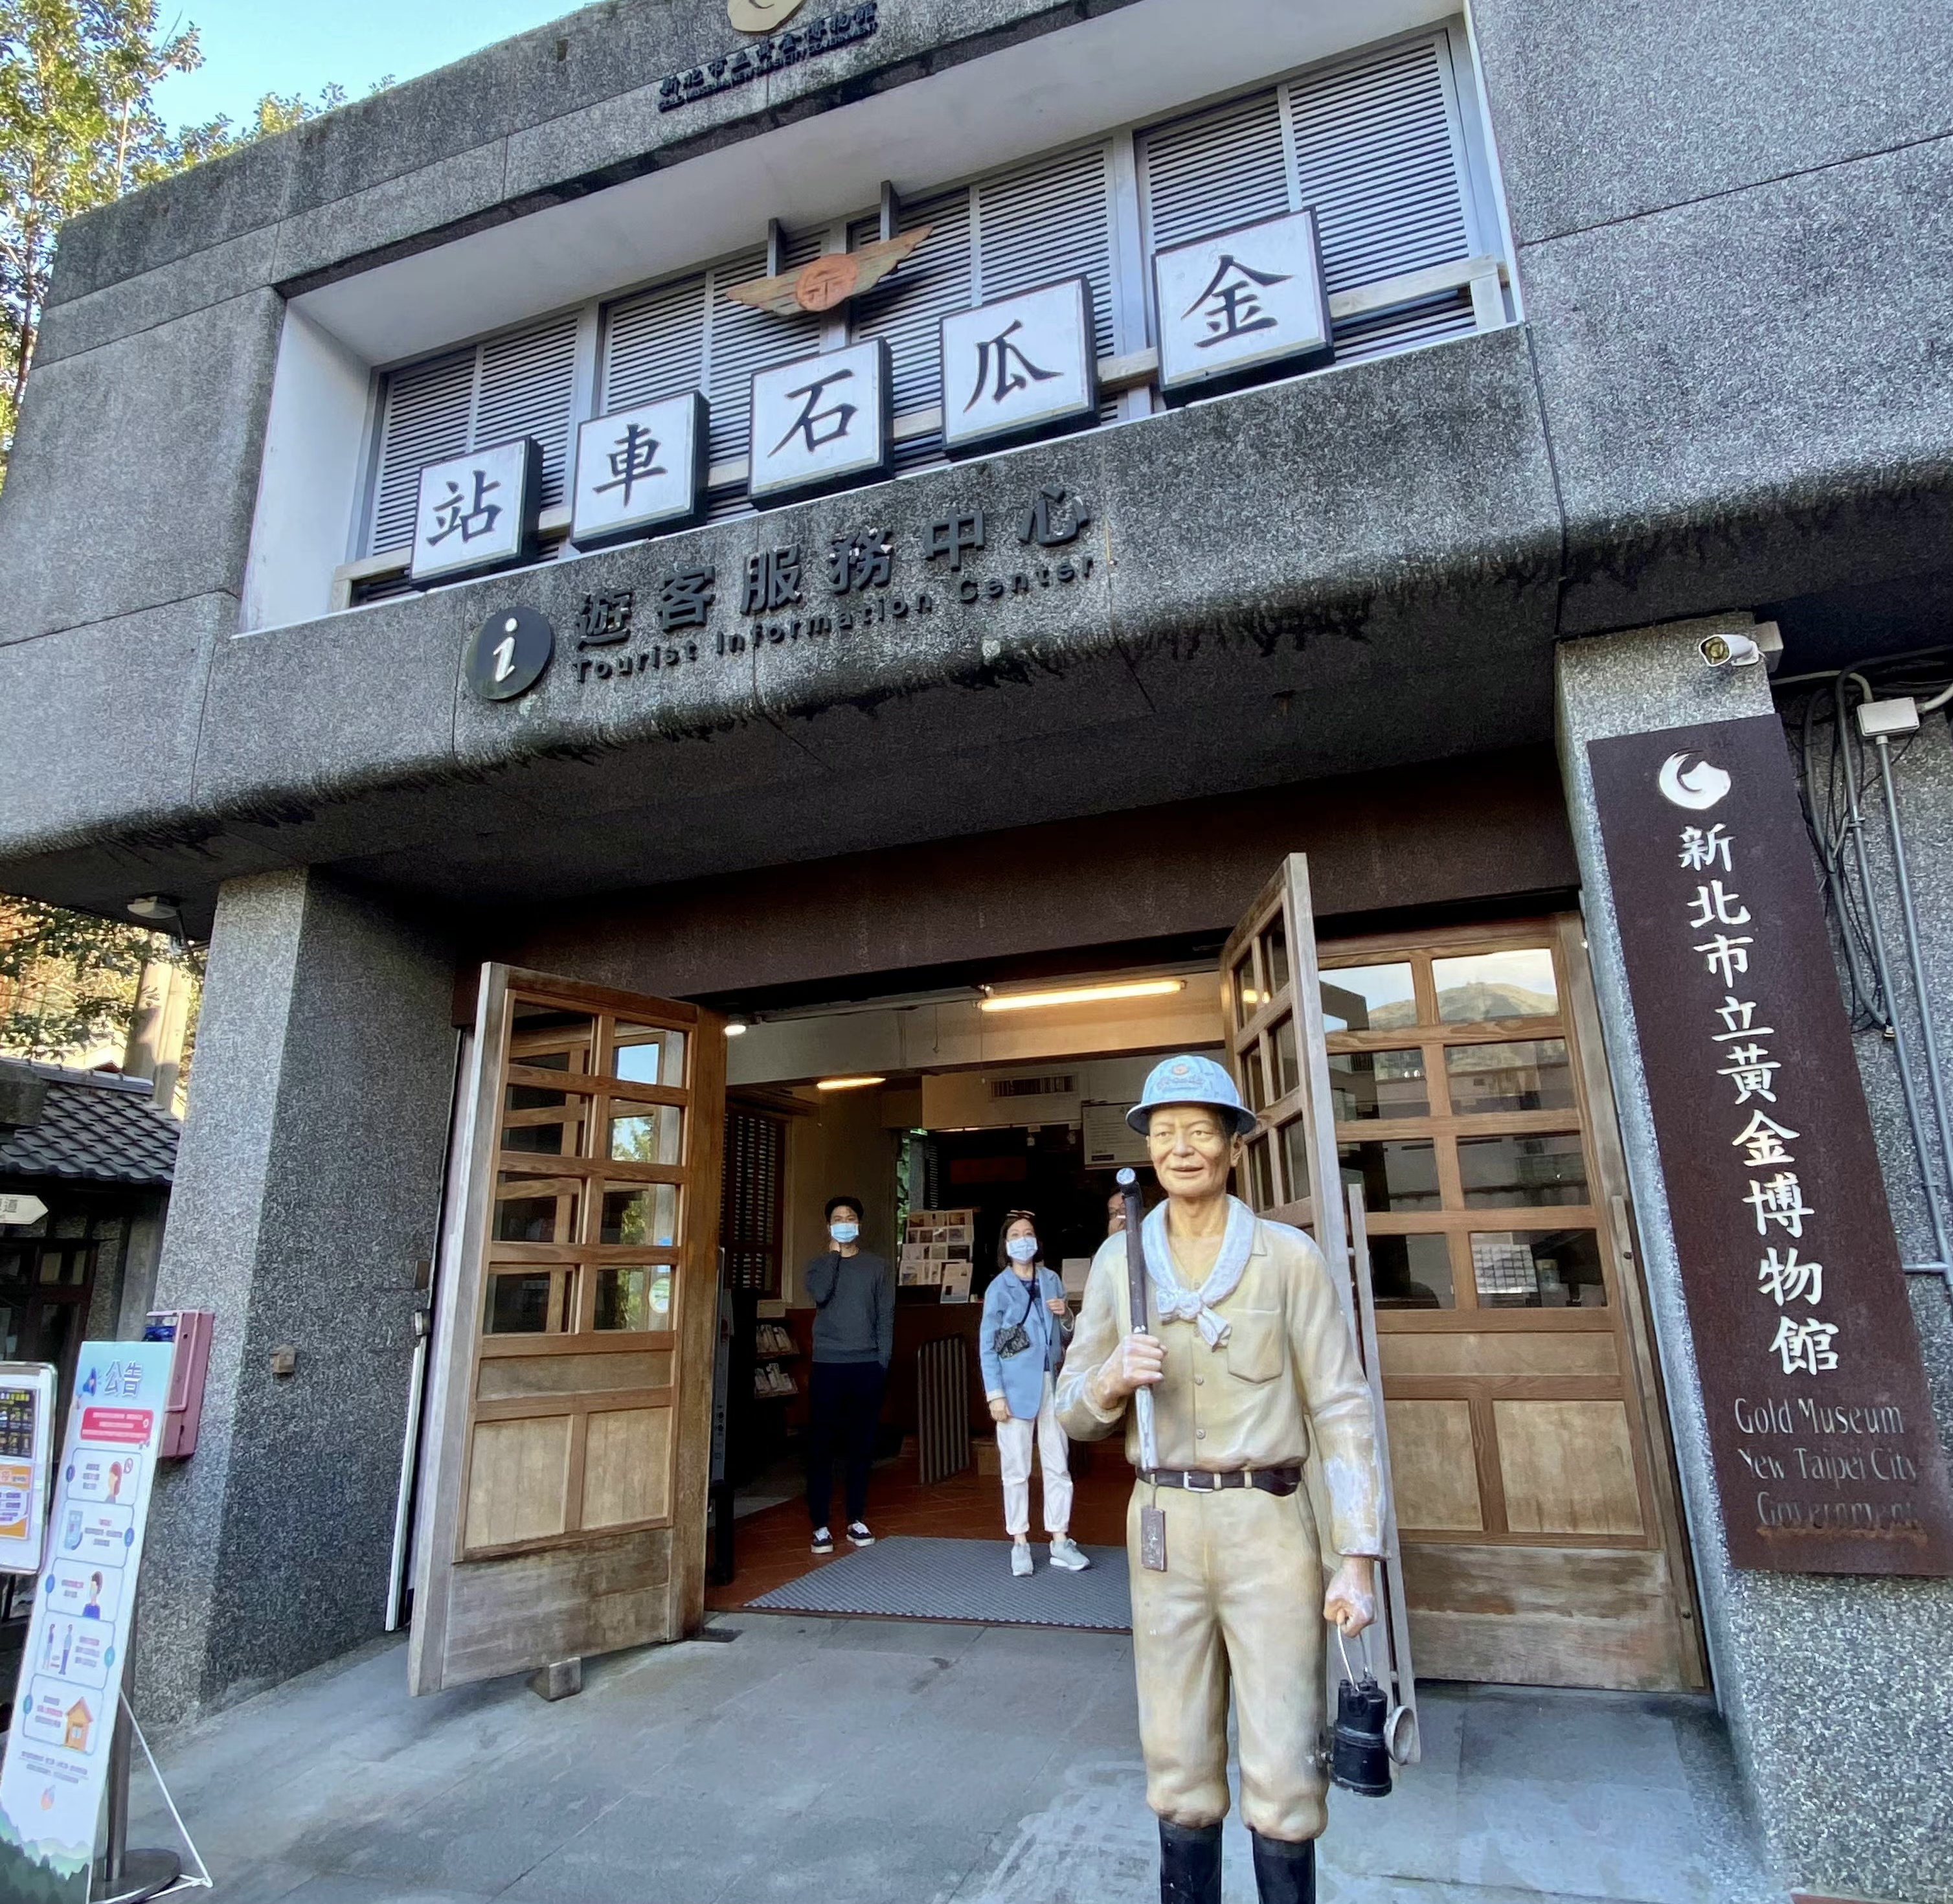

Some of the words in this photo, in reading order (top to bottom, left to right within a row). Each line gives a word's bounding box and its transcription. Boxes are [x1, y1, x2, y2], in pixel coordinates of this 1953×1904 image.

[575, 487, 1091, 649] 遊客服務中心
[573, 644, 697, 684] Tourist
[716, 590, 932, 657] Information
[958, 554, 1096, 602] Center
[1678, 822, 1840, 1376] 新北市立黃金博物館
[104, 1359, 144, 1398] 公告
[1734, 1397, 1794, 1434] Gold
[1797, 1397, 1904, 1434] Museum
[1792, 1447, 1866, 1490] Taipei
